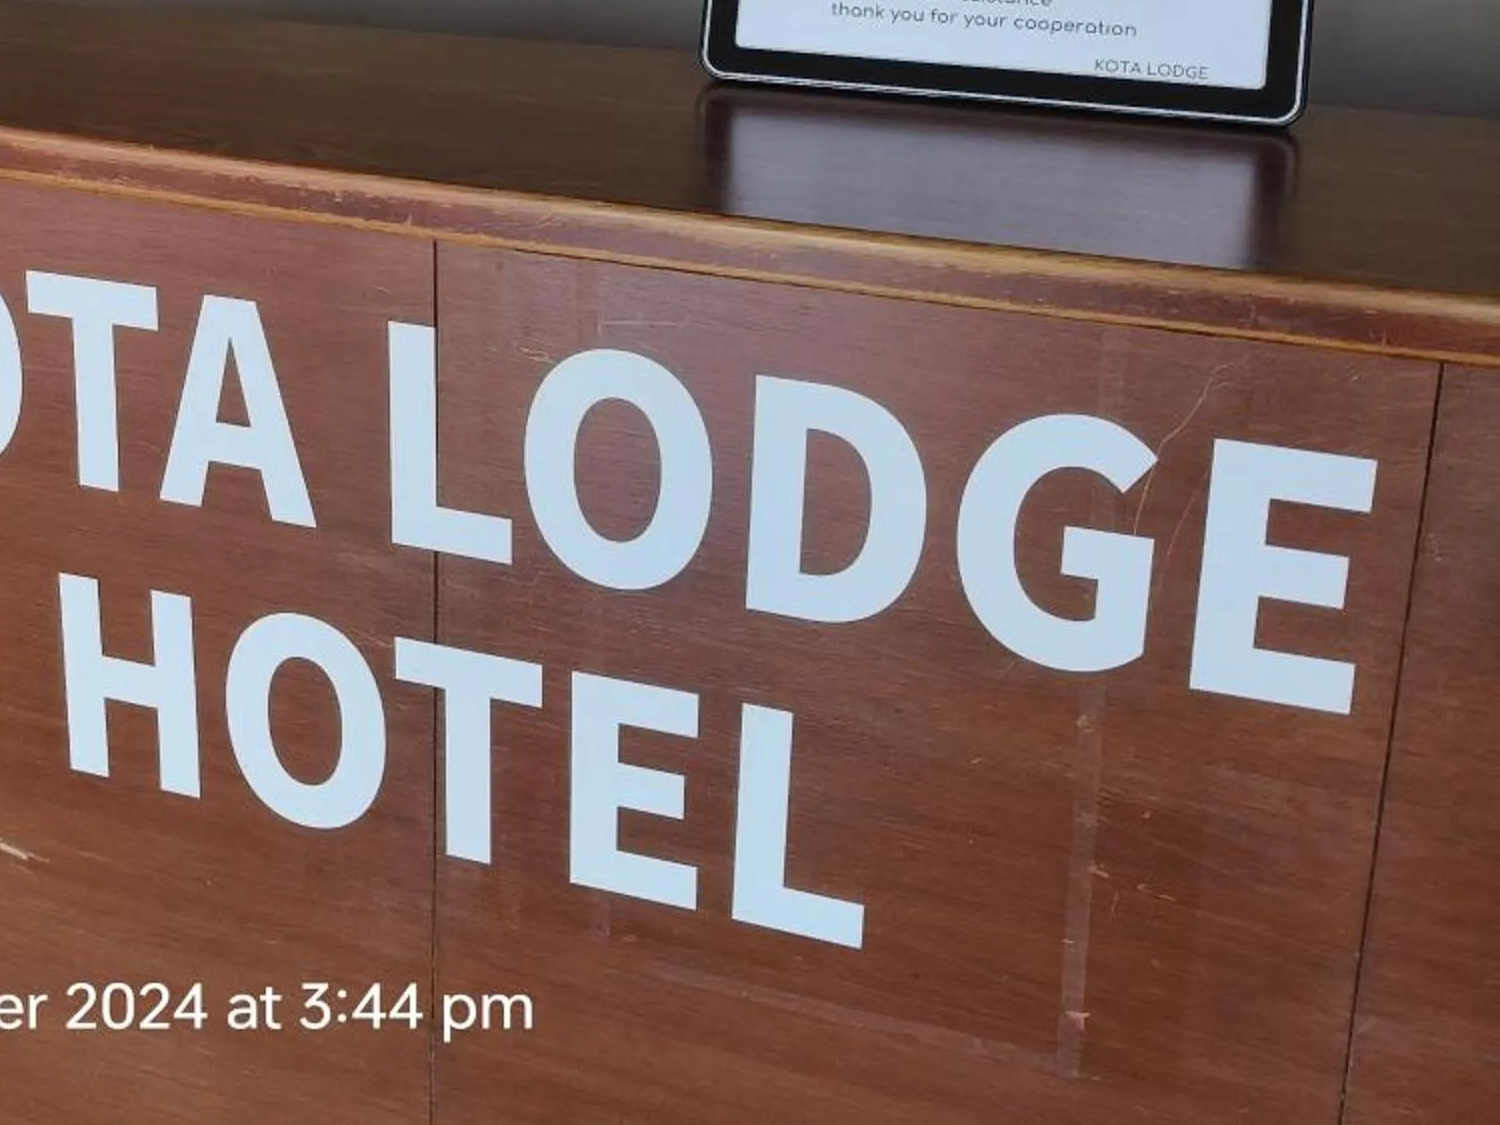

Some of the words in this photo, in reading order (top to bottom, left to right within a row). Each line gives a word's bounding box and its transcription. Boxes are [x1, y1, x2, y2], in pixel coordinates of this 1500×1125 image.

[831, 2, 885, 20] thank
[890, 10, 925, 25] you
[931, 8, 958, 24] for
[963, 14, 1007, 29] your
[1013, 16, 1137, 37] cooperation
[1094, 58, 1141, 74] KOTA
[1147, 62, 1212, 80] LODGE
[387, 320, 1378, 715] LODGE
[58, 571, 865, 950] HOTEL
